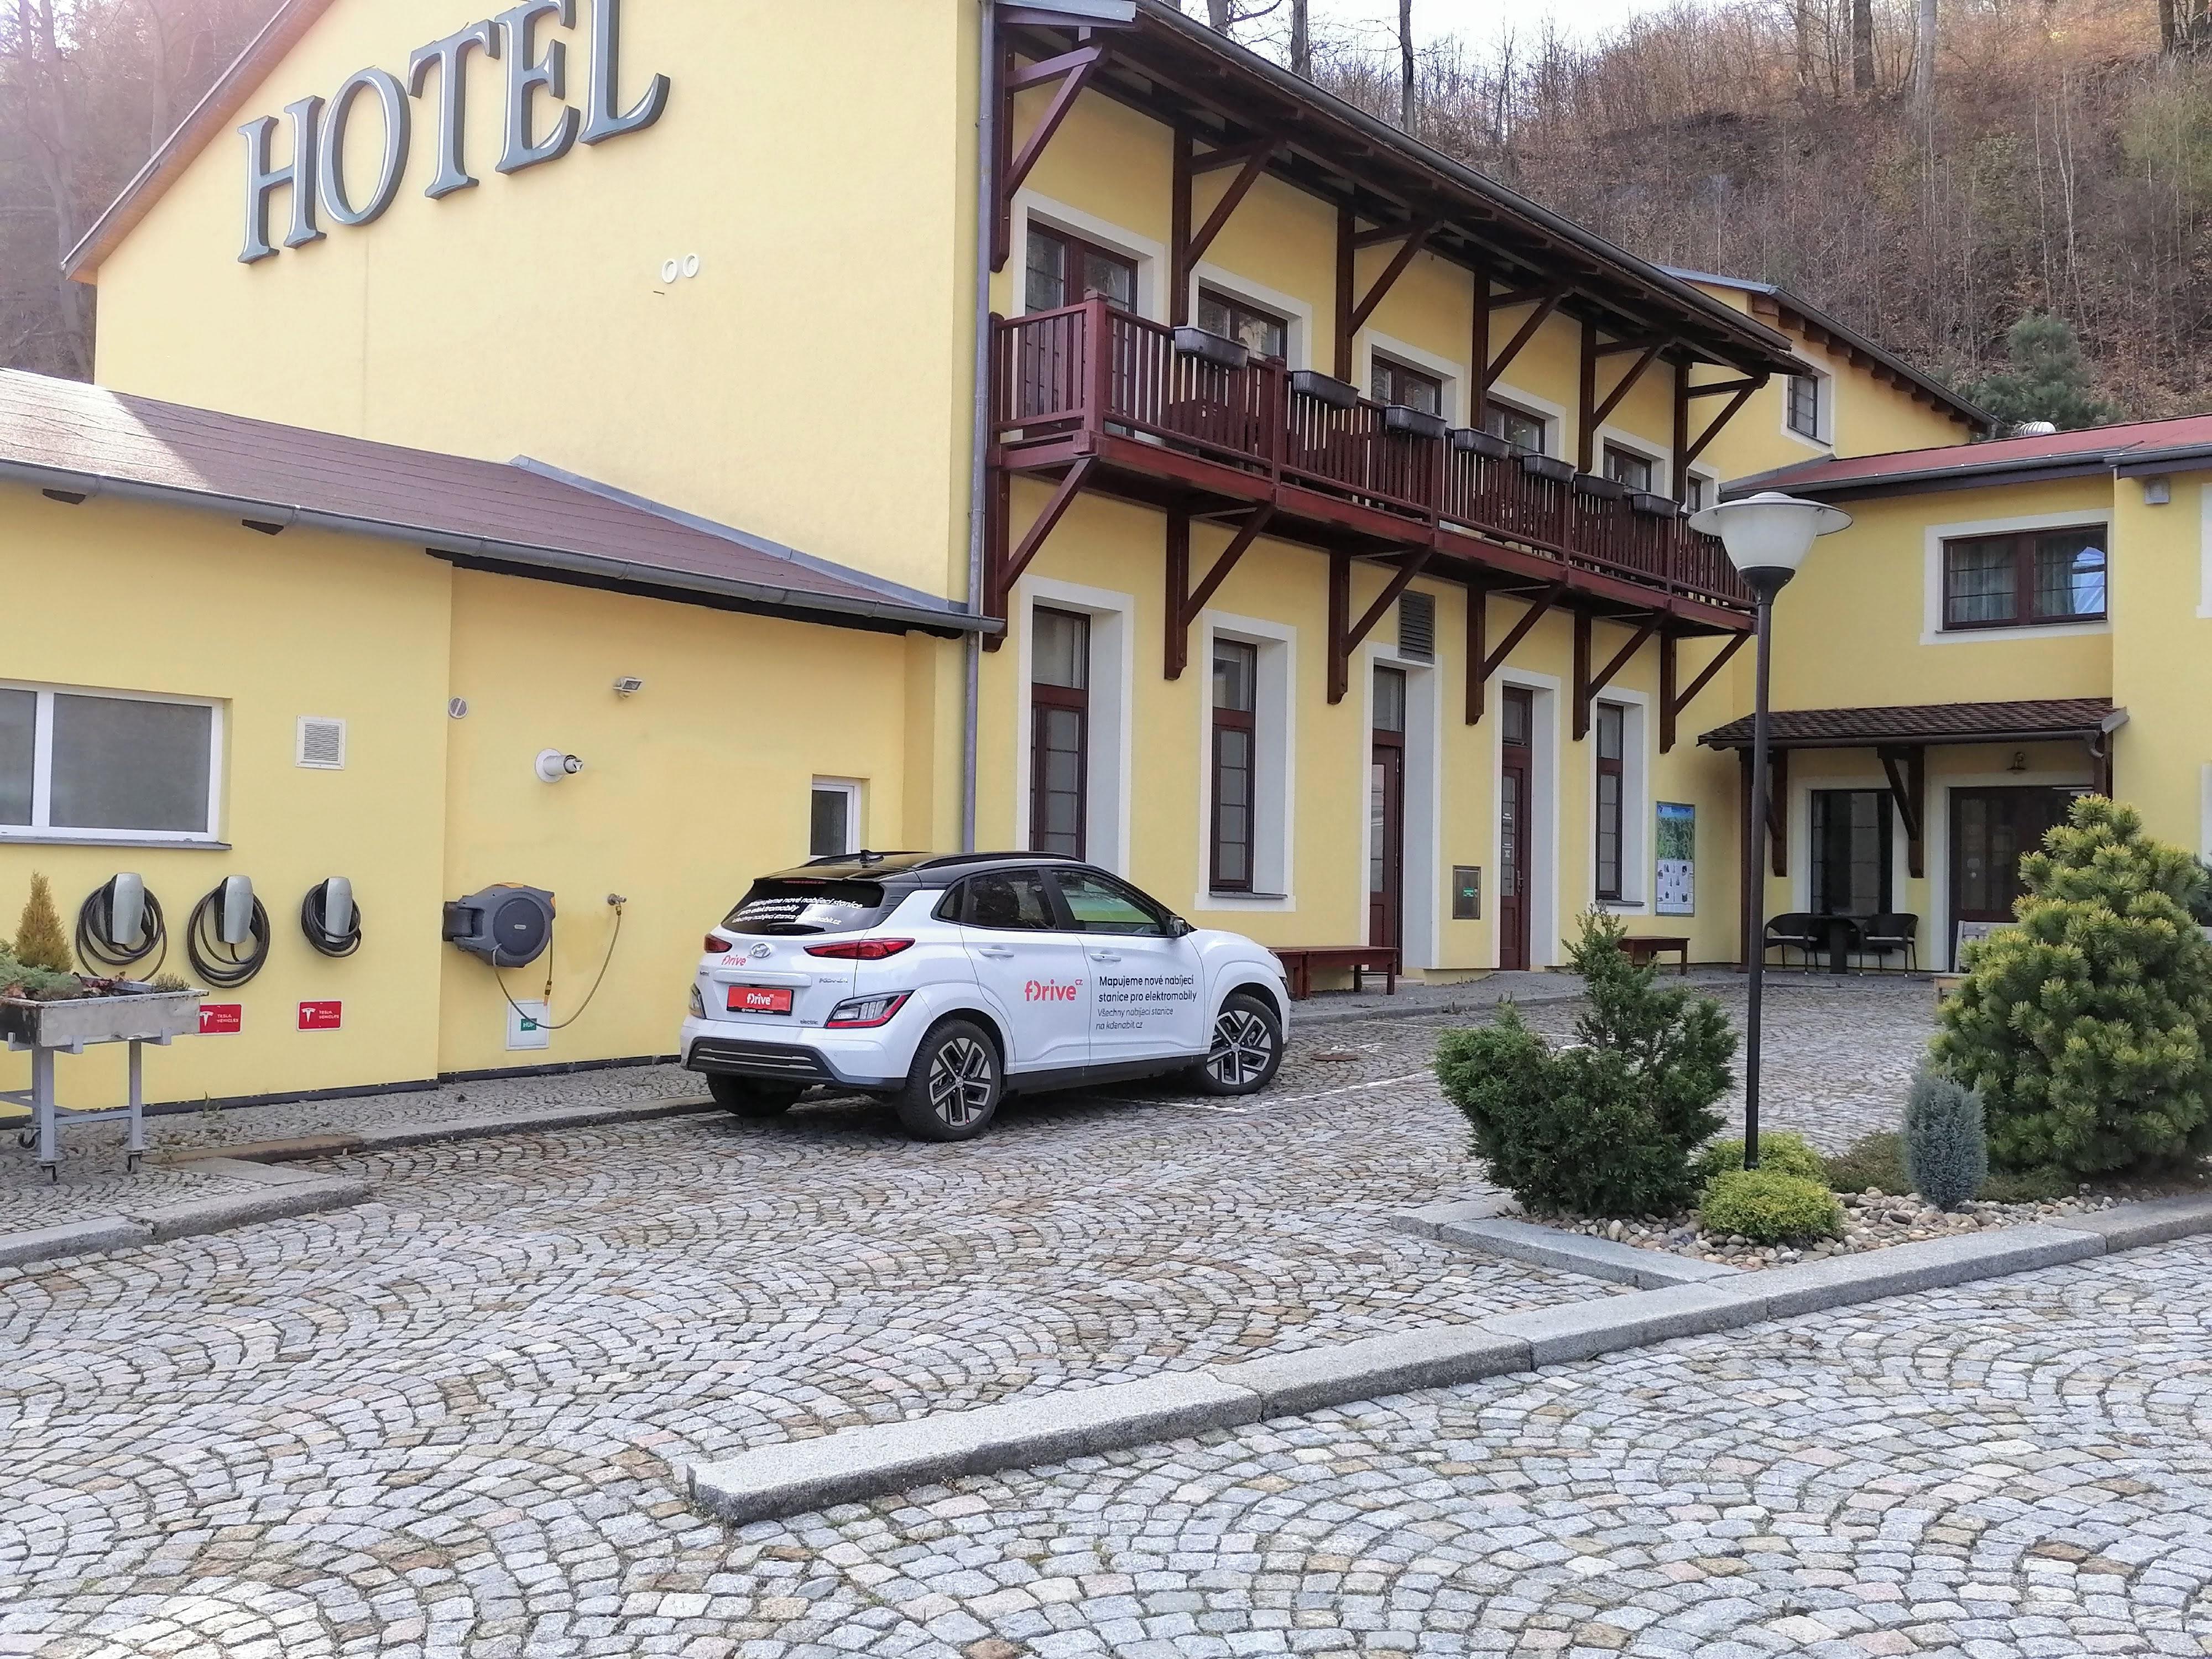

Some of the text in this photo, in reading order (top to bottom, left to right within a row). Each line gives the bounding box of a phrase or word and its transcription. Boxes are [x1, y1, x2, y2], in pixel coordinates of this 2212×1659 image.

[238, 0, 670, 265] HOTEL
[1099, 974, 1194, 989] Mapujeme nové nabíjecí
[1098, 989, 1198, 1004] stanice pro elektromobily
[1097, 1008, 1125, 1019] Všechny
[1151, 1006, 1173, 1016] stanice
